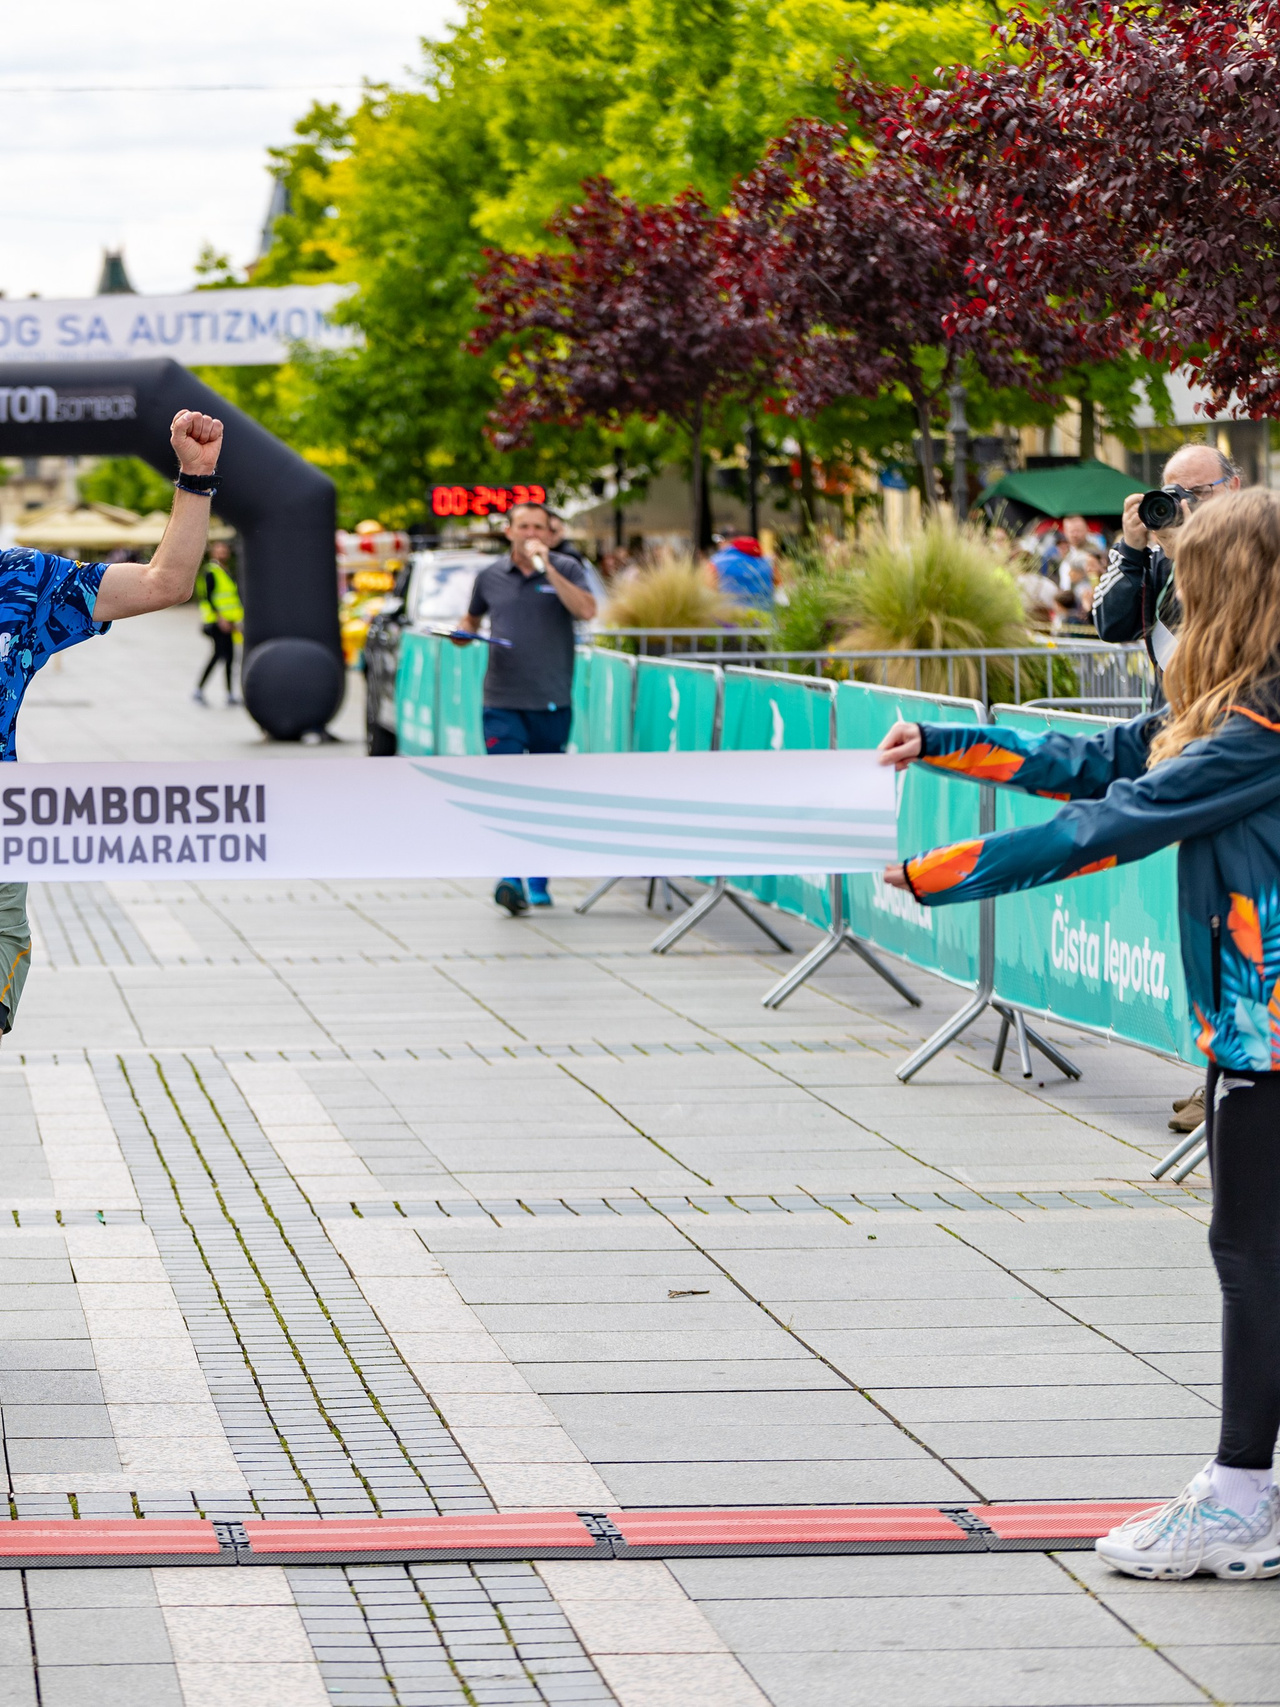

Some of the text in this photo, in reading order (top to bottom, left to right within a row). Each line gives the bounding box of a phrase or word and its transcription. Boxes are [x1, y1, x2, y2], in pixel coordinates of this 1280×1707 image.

[57, 312, 112, 347] SA
[2, 785, 266, 826] SOMBORSKI
[3, 834, 267, 865] POLUMARATON
[1051, 893, 1170, 1002] Čista lepota.
